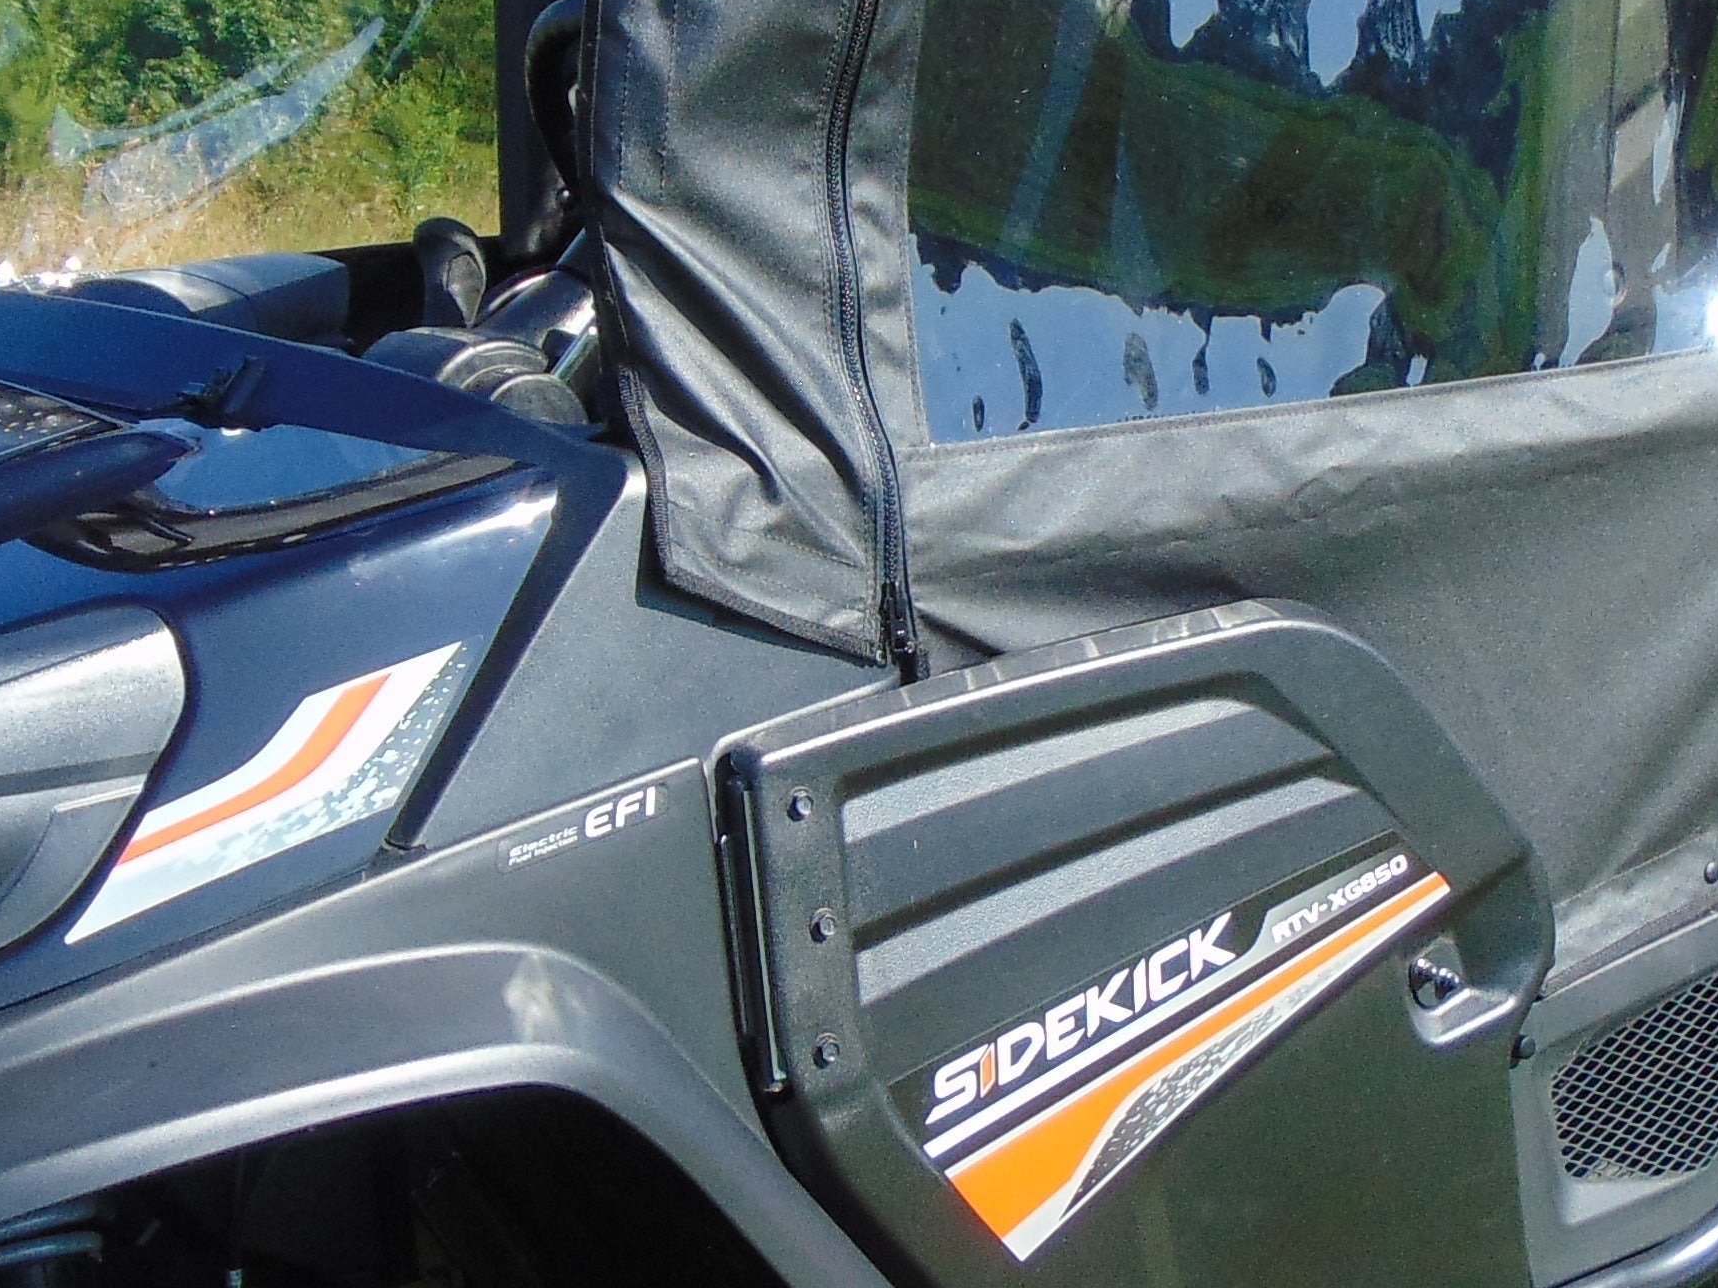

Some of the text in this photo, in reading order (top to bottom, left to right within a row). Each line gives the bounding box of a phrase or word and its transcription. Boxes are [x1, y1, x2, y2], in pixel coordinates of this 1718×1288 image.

[584, 785, 656, 839] EFI
[508, 850, 532, 866] Fuel
[509, 826, 578, 857] Electric
[924, 853, 1409, 1125] SIDEKICK RTV-XG850
